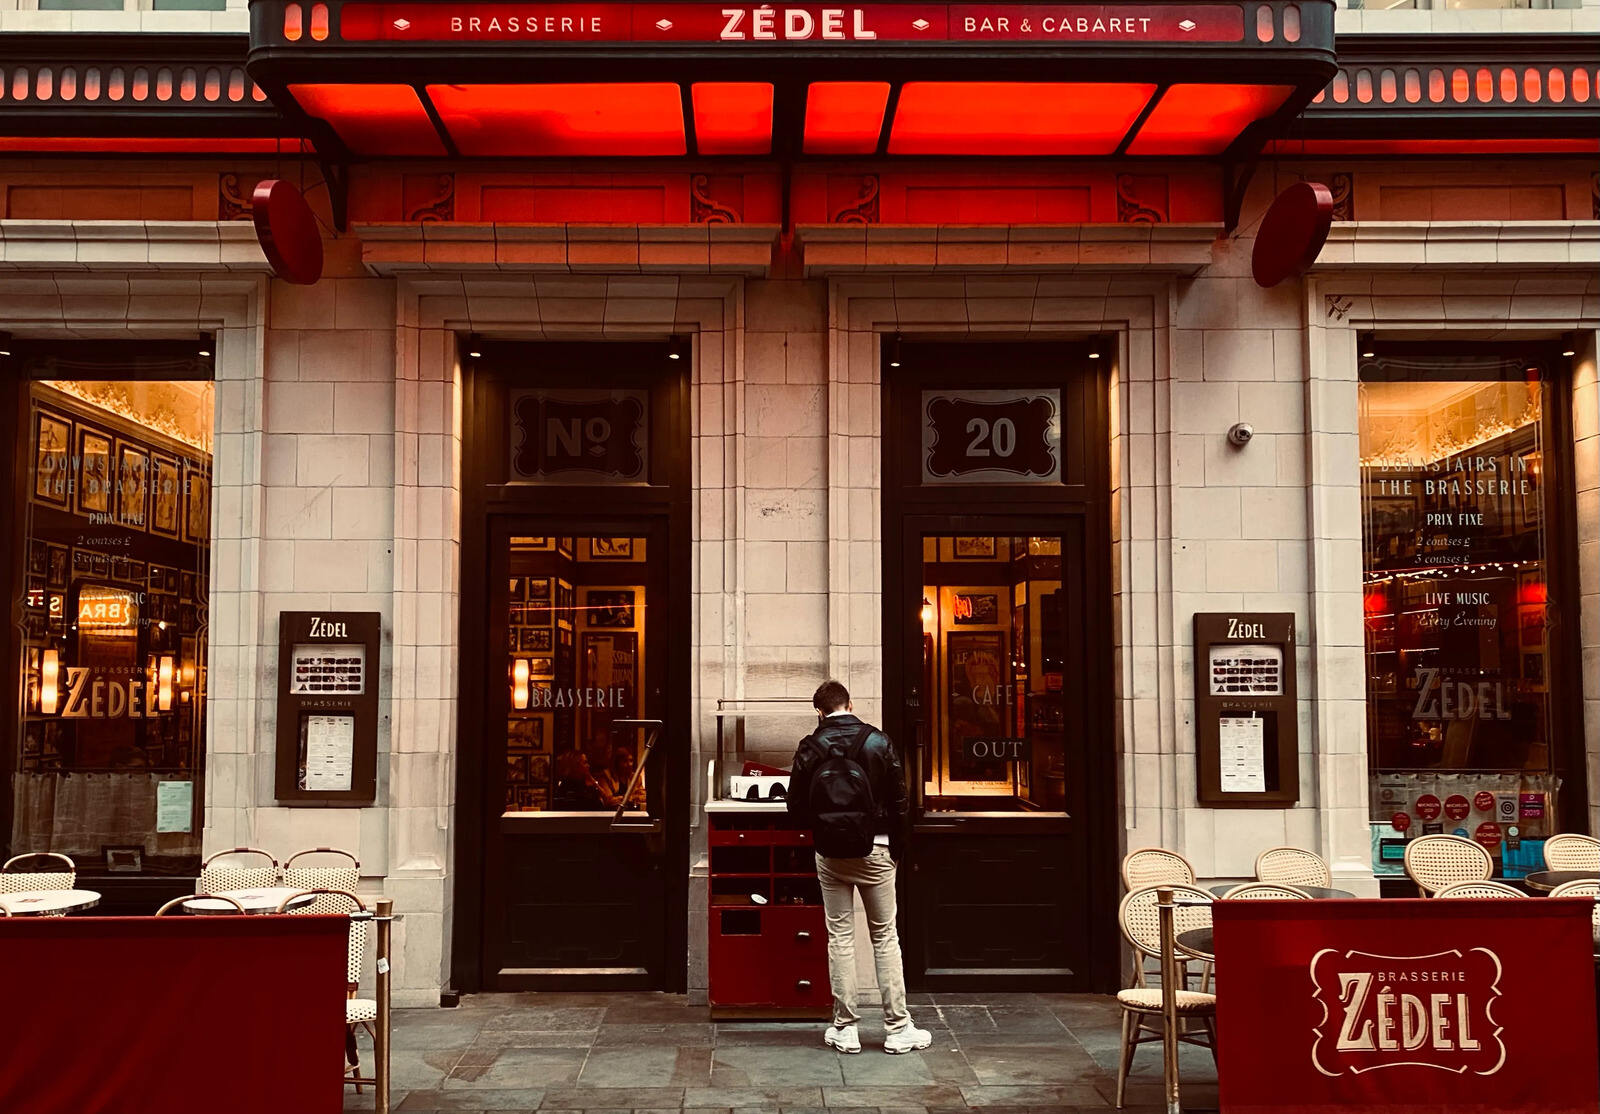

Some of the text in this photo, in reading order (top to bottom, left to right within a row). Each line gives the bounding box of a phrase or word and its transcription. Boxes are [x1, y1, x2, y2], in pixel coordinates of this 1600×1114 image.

[451, 4, 877, 41] BRASSERIE ZÉDEL
[965, 17, 1151, 33] BAR & CABARET
[966, 417, 1016, 457] 20
[46, 455, 192, 473] DOWNSTAIRS IN
[1381, 456, 1528, 472] DOWNSTAIRS IN
[44, 478, 192, 495] THE BRASSERIE
[1379, 479, 1529, 495] THE BRASSERIE
[88, 512, 145, 526] PRIX FIXE
[1426, 513, 1484, 526] PRIX FIXE
[76, 535, 84, 546] 2
[86, 537, 122, 546] courses
[1416, 536, 1471, 547] 2 courses £
[1414, 554, 1470, 565] 3 courses £
[1425, 592, 1490, 605] LIVE MUSIC
[1419, 611, 1497, 629] Every Evening
[61, 667, 159, 719] ZÉDEL
[532, 687, 625, 708] BRASSERIE
[1412, 667, 1512, 720] ZÉDEL
[972, 741, 1023, 758] OUT
[1378, 971, 1466, 982] BRASSERIE
[1336, 972, 1481, 1052] ZÉDEL
